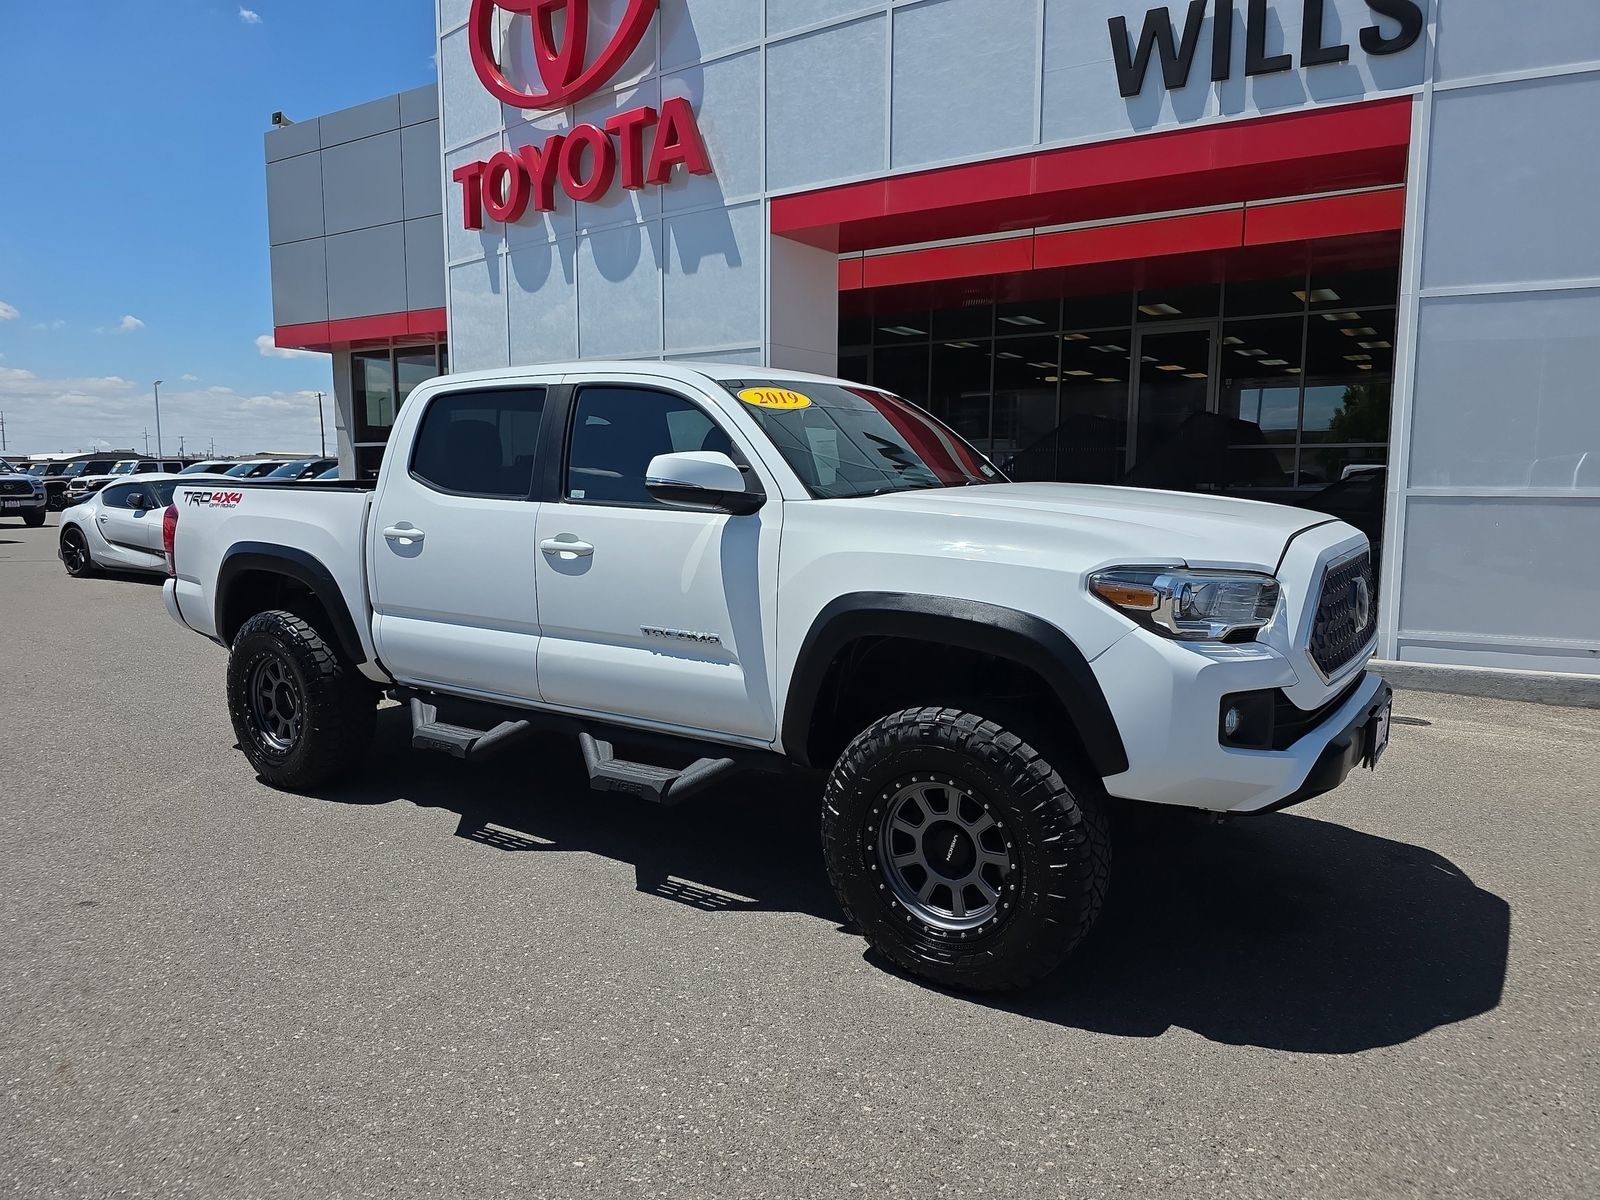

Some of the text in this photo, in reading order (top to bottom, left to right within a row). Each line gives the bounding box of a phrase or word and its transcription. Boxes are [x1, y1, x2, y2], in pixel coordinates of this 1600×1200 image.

[1107, 0, 1423, 98] WILLS
[453, 97, 712, 231] TOYOTA
[753, 391, 799, 404] 2019
